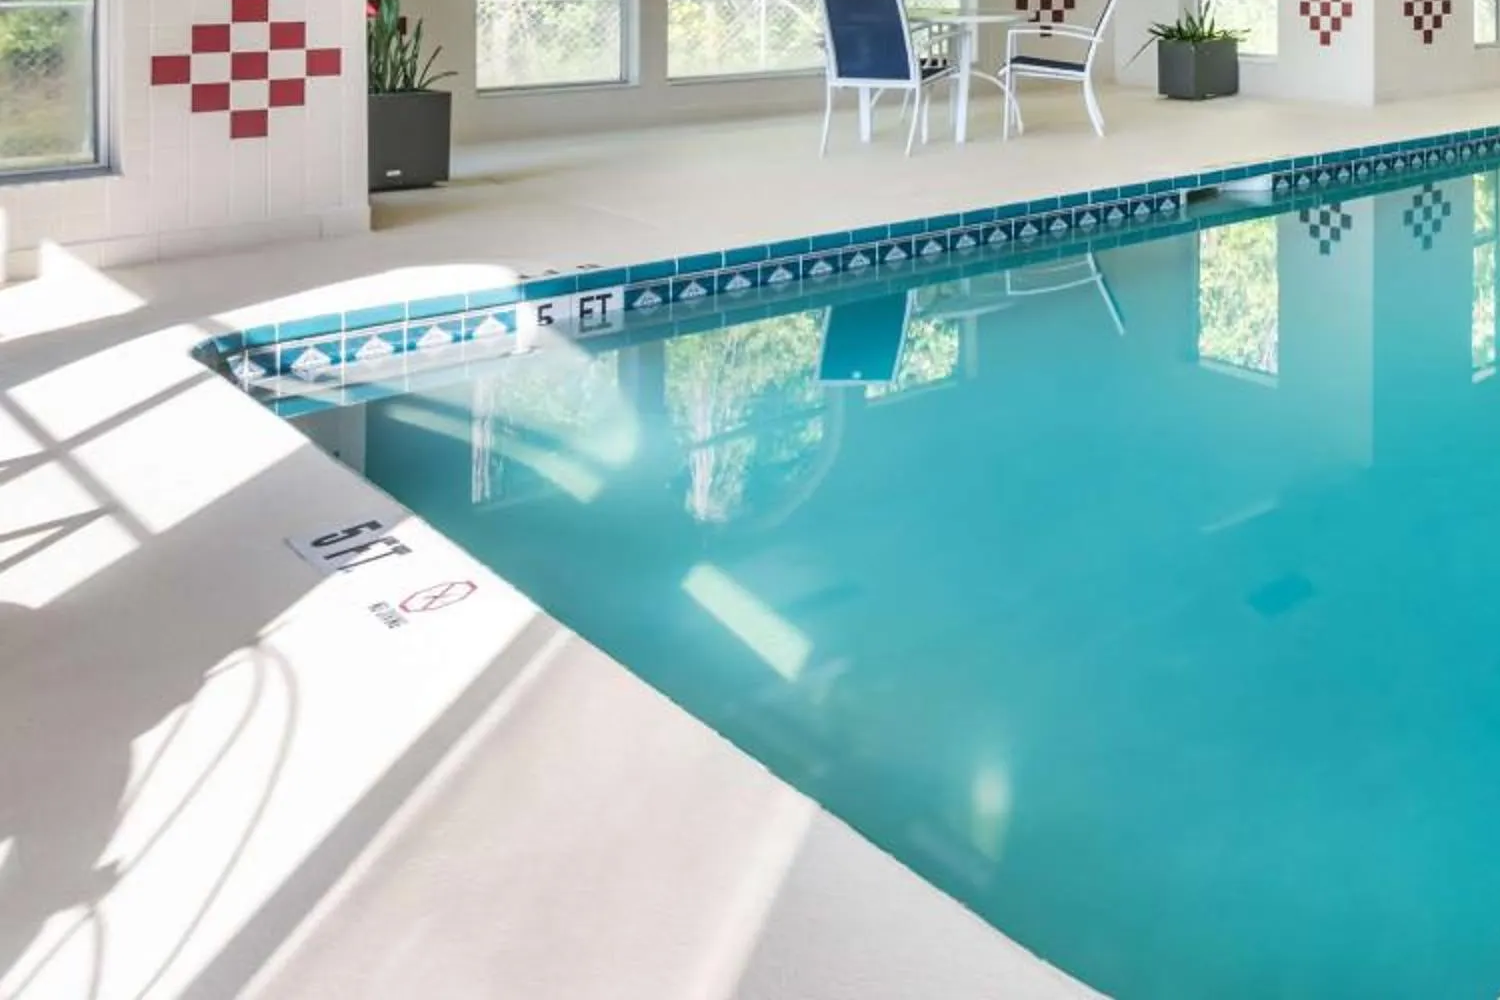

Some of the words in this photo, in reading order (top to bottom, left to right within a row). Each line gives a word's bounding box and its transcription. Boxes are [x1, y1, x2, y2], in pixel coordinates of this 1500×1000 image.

[537, 303, 554, 325] 5
[579, 293, 612, 318] FT
[310, 519, 383, 547] 5
